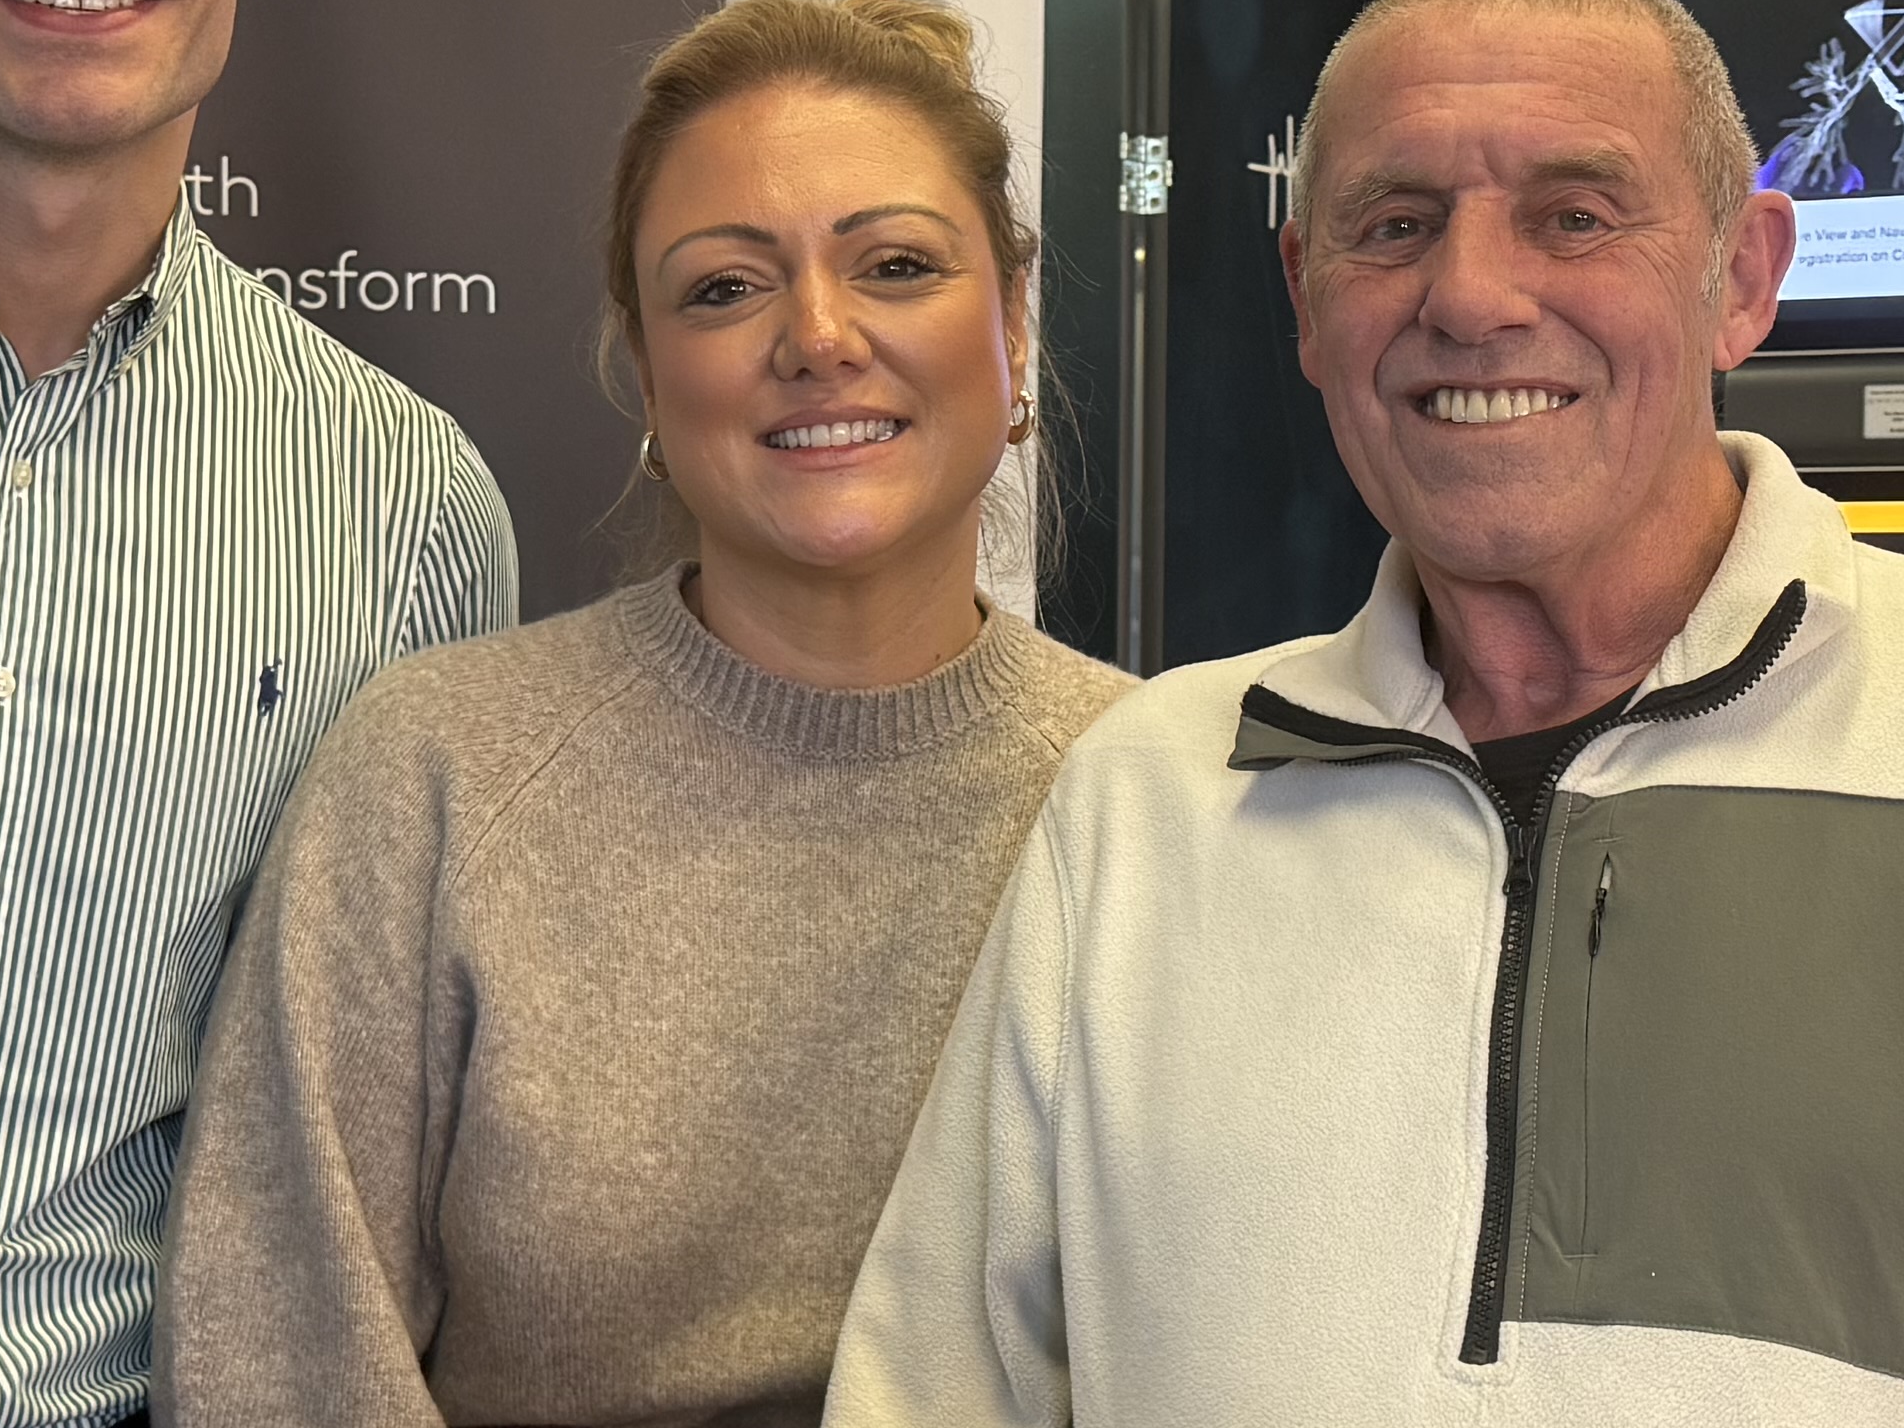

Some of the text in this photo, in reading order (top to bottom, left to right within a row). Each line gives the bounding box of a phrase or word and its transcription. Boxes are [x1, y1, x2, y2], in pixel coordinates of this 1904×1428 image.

[185, 155, 259, 217] th
[1850, 226, 1876, 241] and
[1871, 250, 1888, 262] on
[256, 249, 496, 314] nsform
